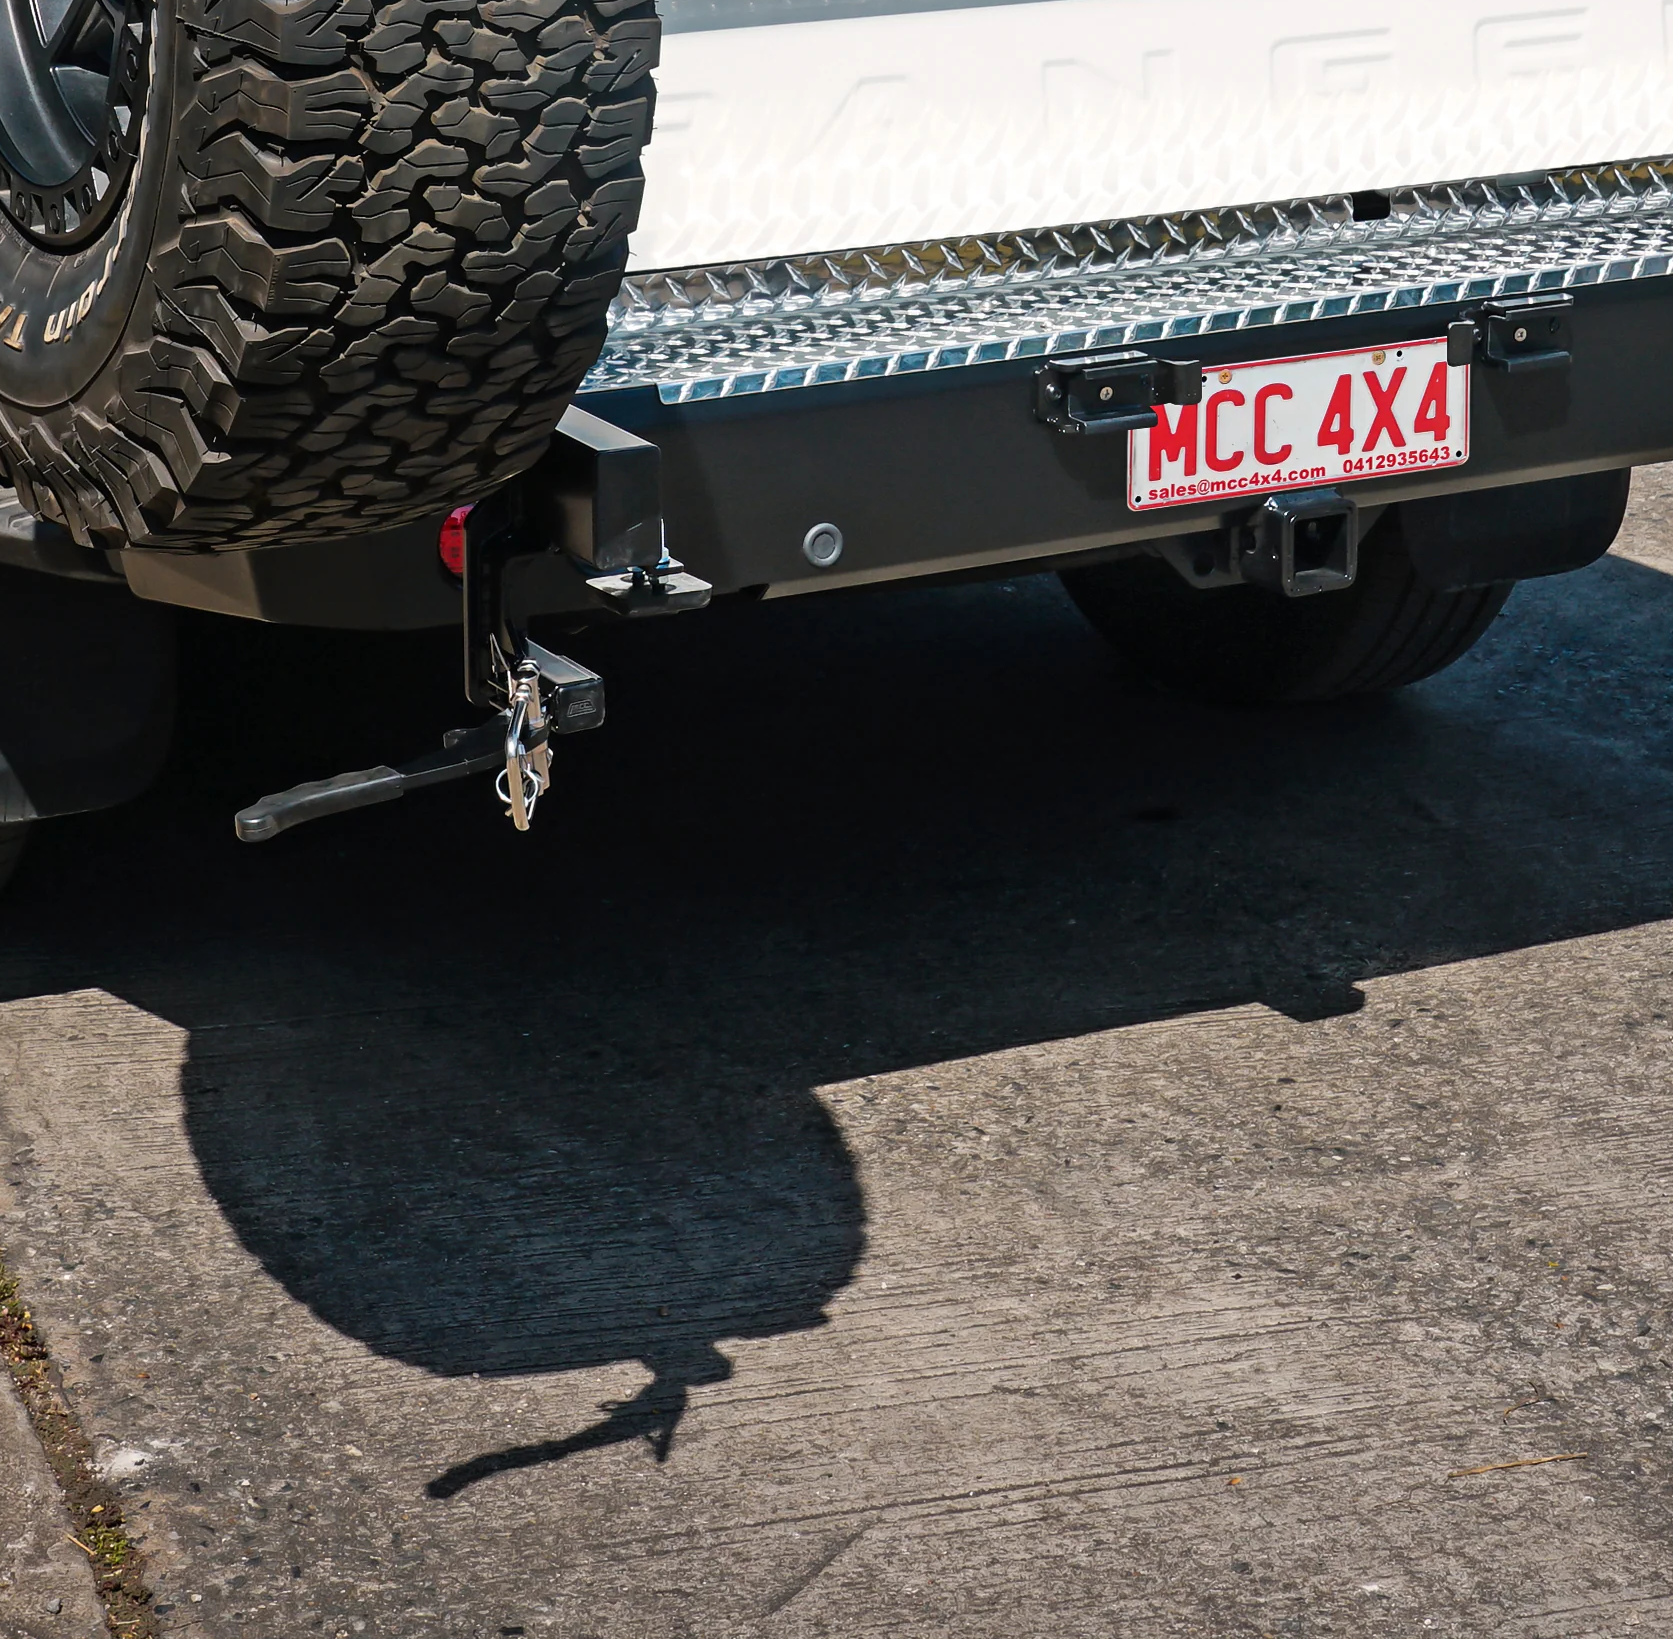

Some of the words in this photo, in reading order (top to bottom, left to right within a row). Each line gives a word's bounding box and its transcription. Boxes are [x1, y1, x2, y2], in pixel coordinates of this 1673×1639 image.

[1148, 381, 1294, 482] MCC
[1316, 360, 1451, 456] 4X4
[1147, 464, 1327, 501] sales@mcc4x4.com
[1342, 445, 1452, 475] 0412935643
